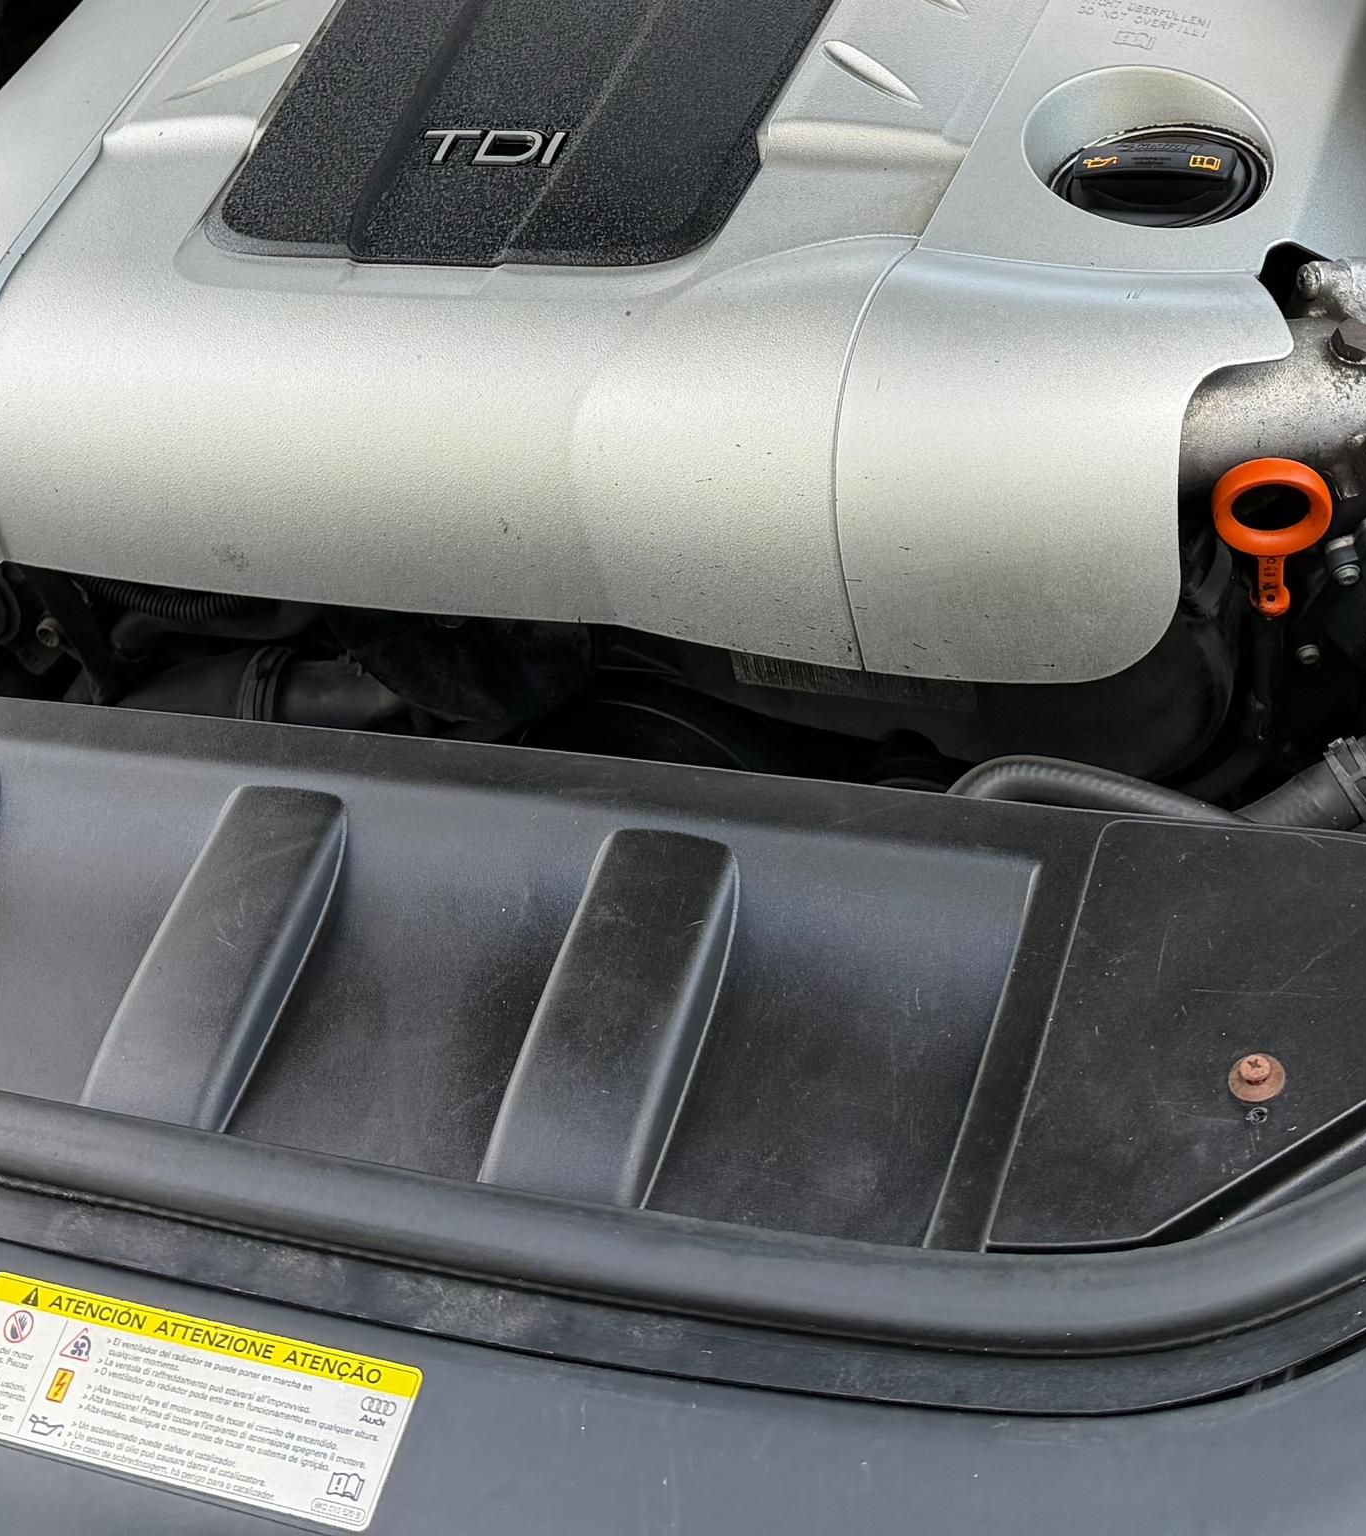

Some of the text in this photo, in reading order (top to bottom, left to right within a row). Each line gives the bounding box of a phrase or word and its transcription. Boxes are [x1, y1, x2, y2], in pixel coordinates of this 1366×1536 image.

[423, 129, 570, 166] TDI
[49, 1295, 382, 1384] ATENCIÓN ATTENZIONE ATENÇÃO
[359, 1414, 386, 1427] Audi
